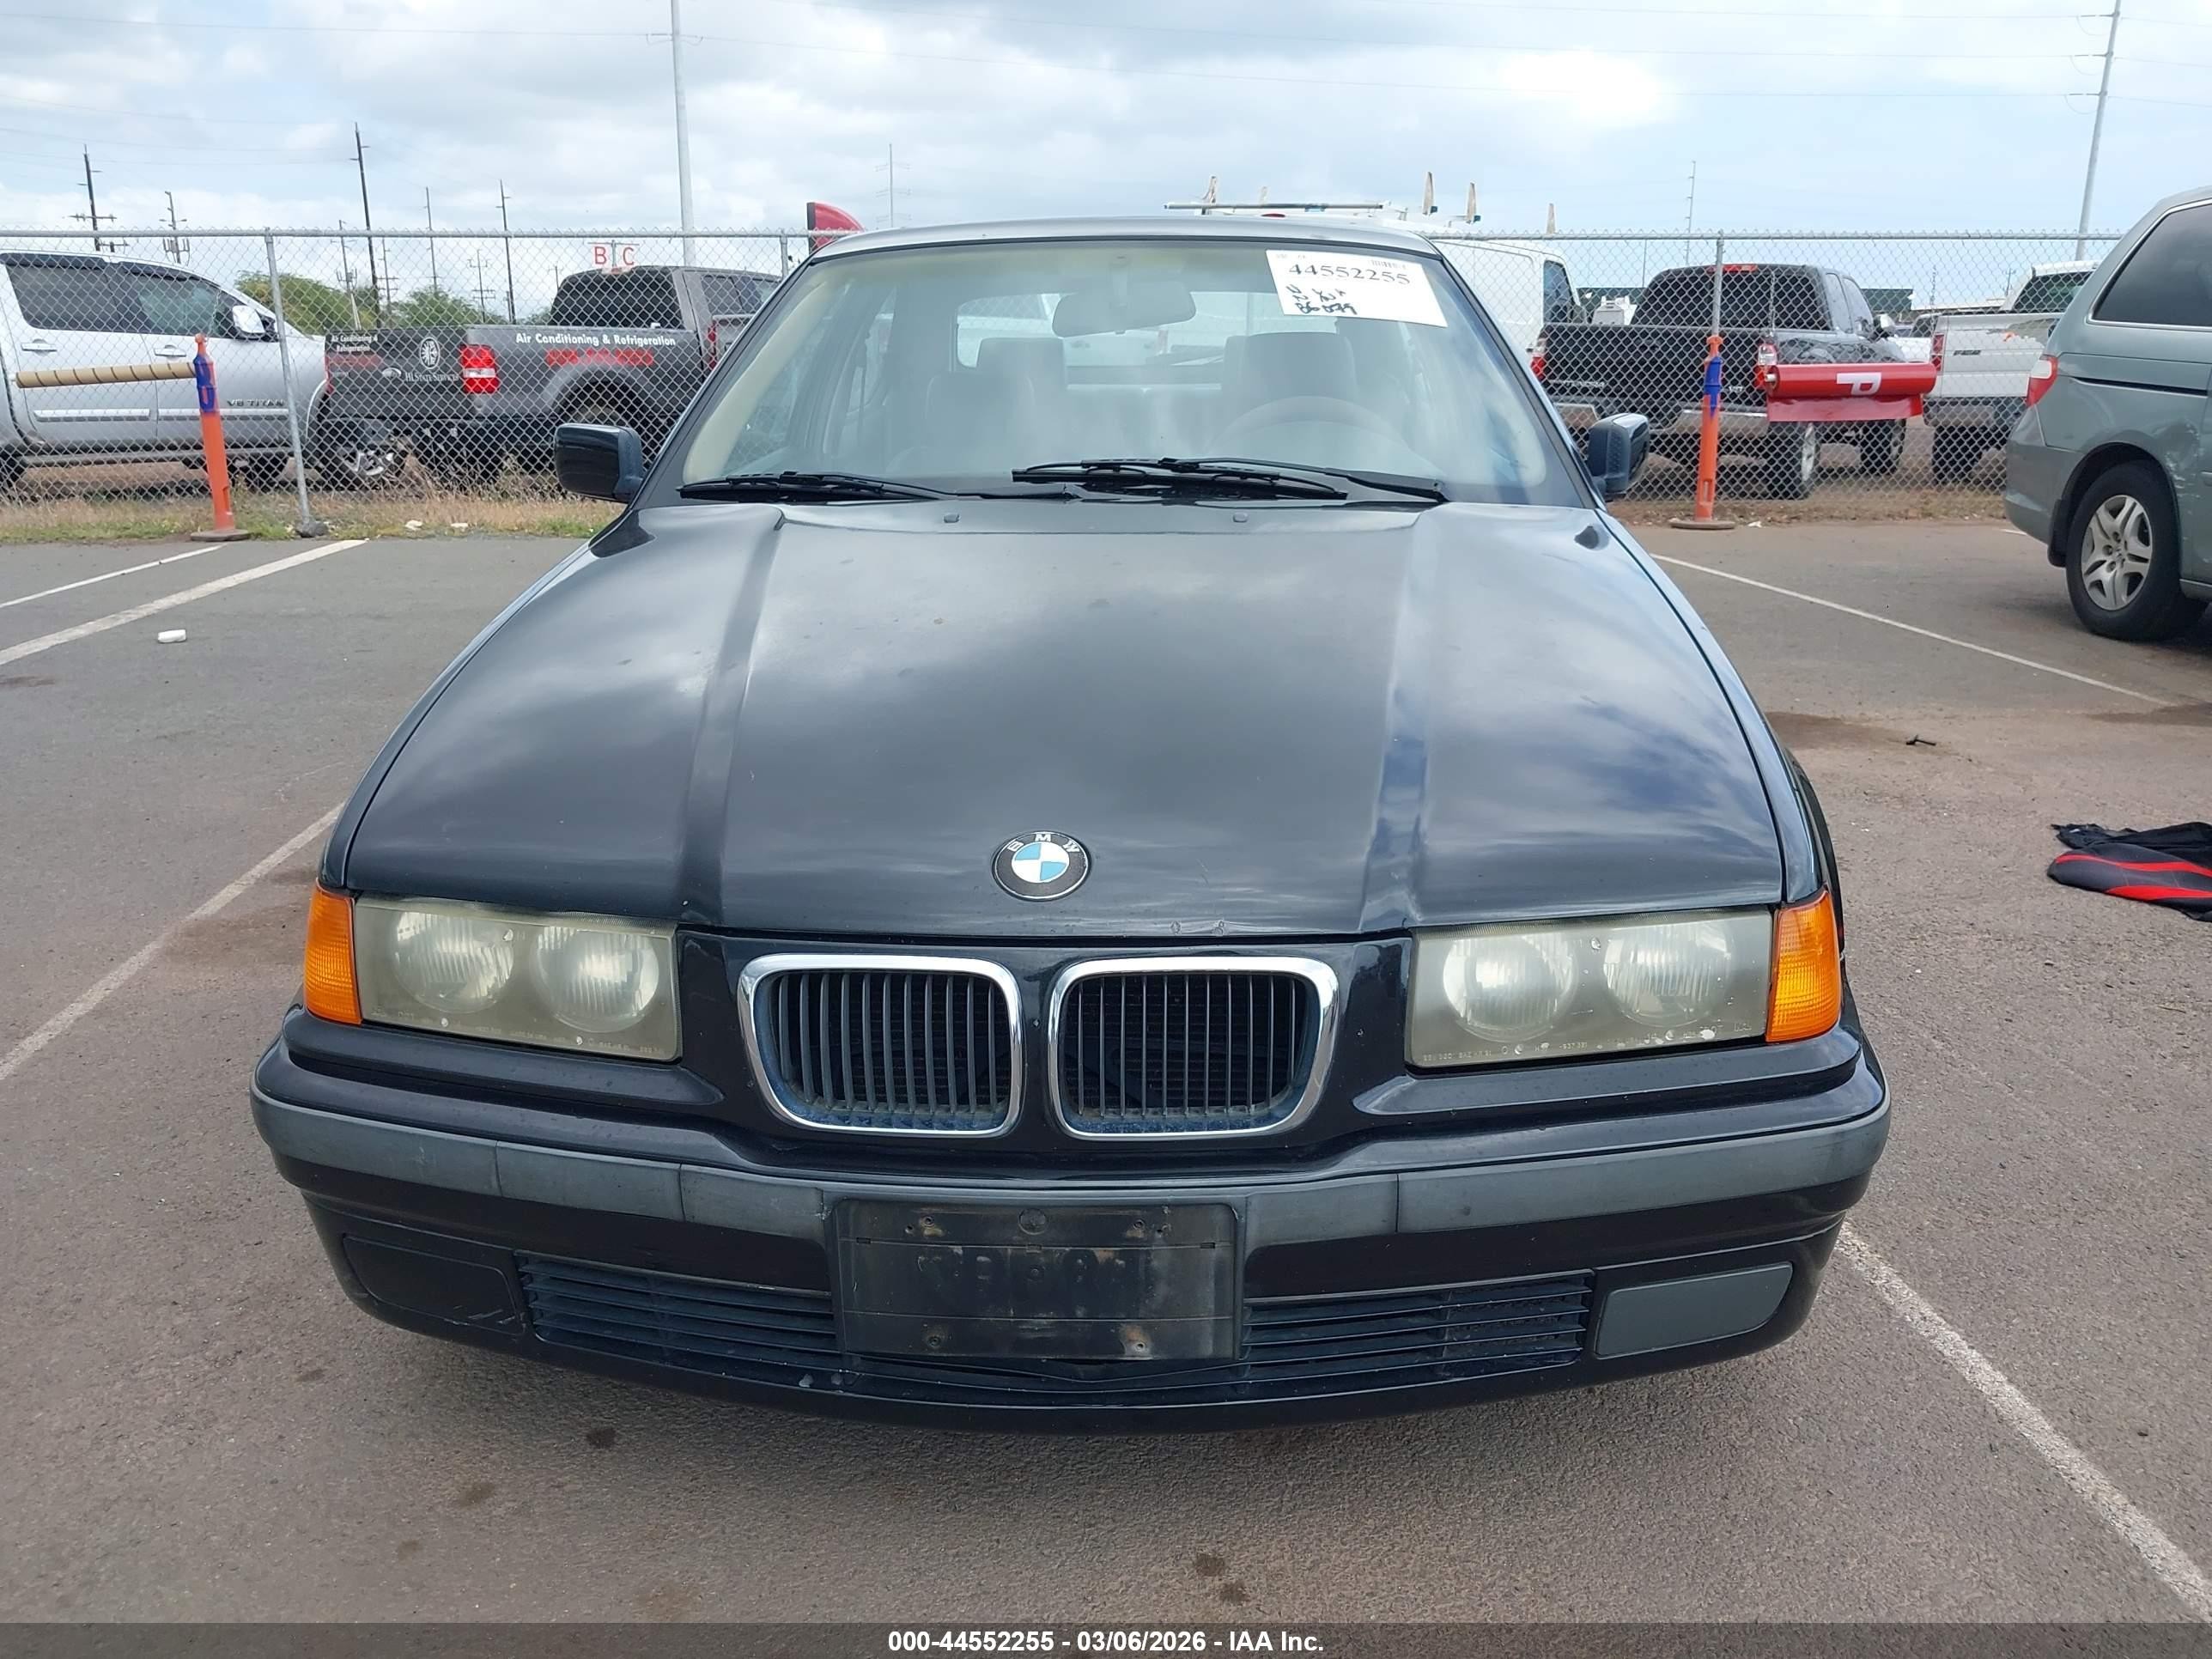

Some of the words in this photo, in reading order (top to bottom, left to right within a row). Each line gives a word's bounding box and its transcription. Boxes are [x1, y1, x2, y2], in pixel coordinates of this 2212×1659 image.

[594, 246, 607, 265] B
[623, 246, 635, 266] C
[1289, 264, 1411, 285] 44552255
[515, 332, 532, 344] Air
[536, 333, 599, 346] Conditioning
[603, 334, 611, 344] &
[614, 334, 676, 347] Refrigeration
[1007, 832, 1081, 853] BMW
